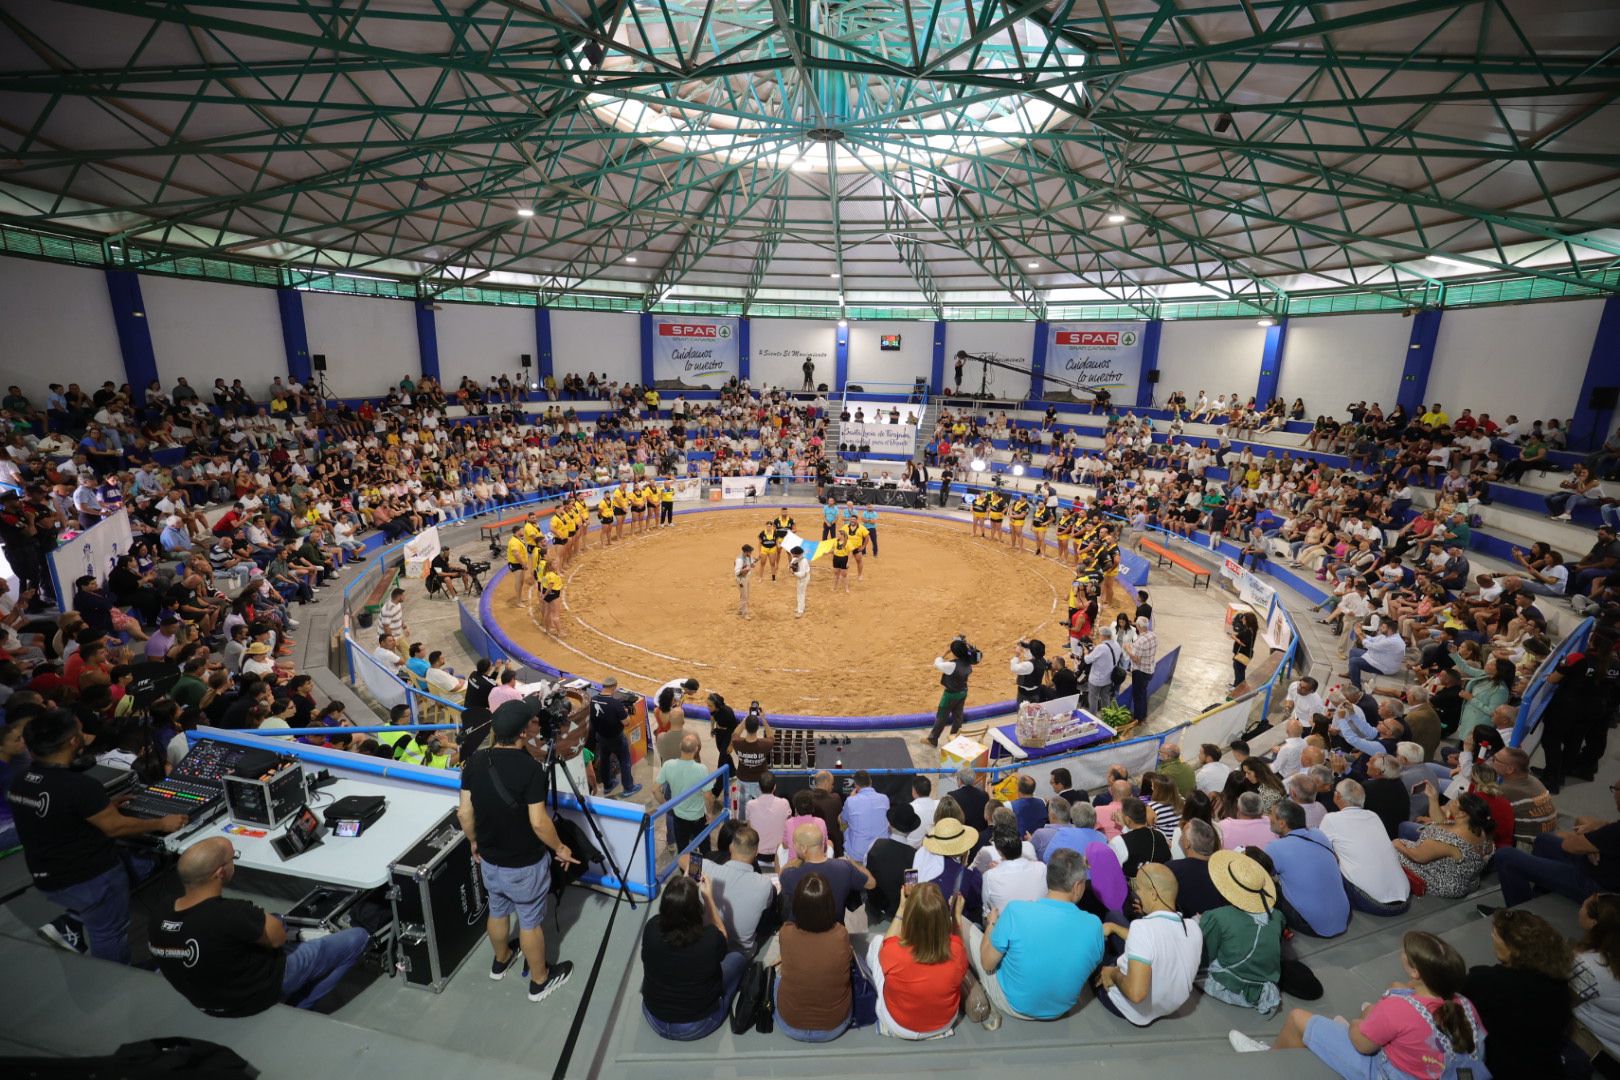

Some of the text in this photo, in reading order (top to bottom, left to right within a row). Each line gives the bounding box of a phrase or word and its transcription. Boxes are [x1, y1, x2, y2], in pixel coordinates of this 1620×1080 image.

[672, 325, 716, 336] SPAR
[1070, 333, 1118, 344] SPAR
[672, 347, 712, 360] Cuidamos
[685, 360, 723, 371] lo nuestro
[1066, 356, 1111, 371] Cuidamos
[1078, 370, 1124, 383] lo nuestro
